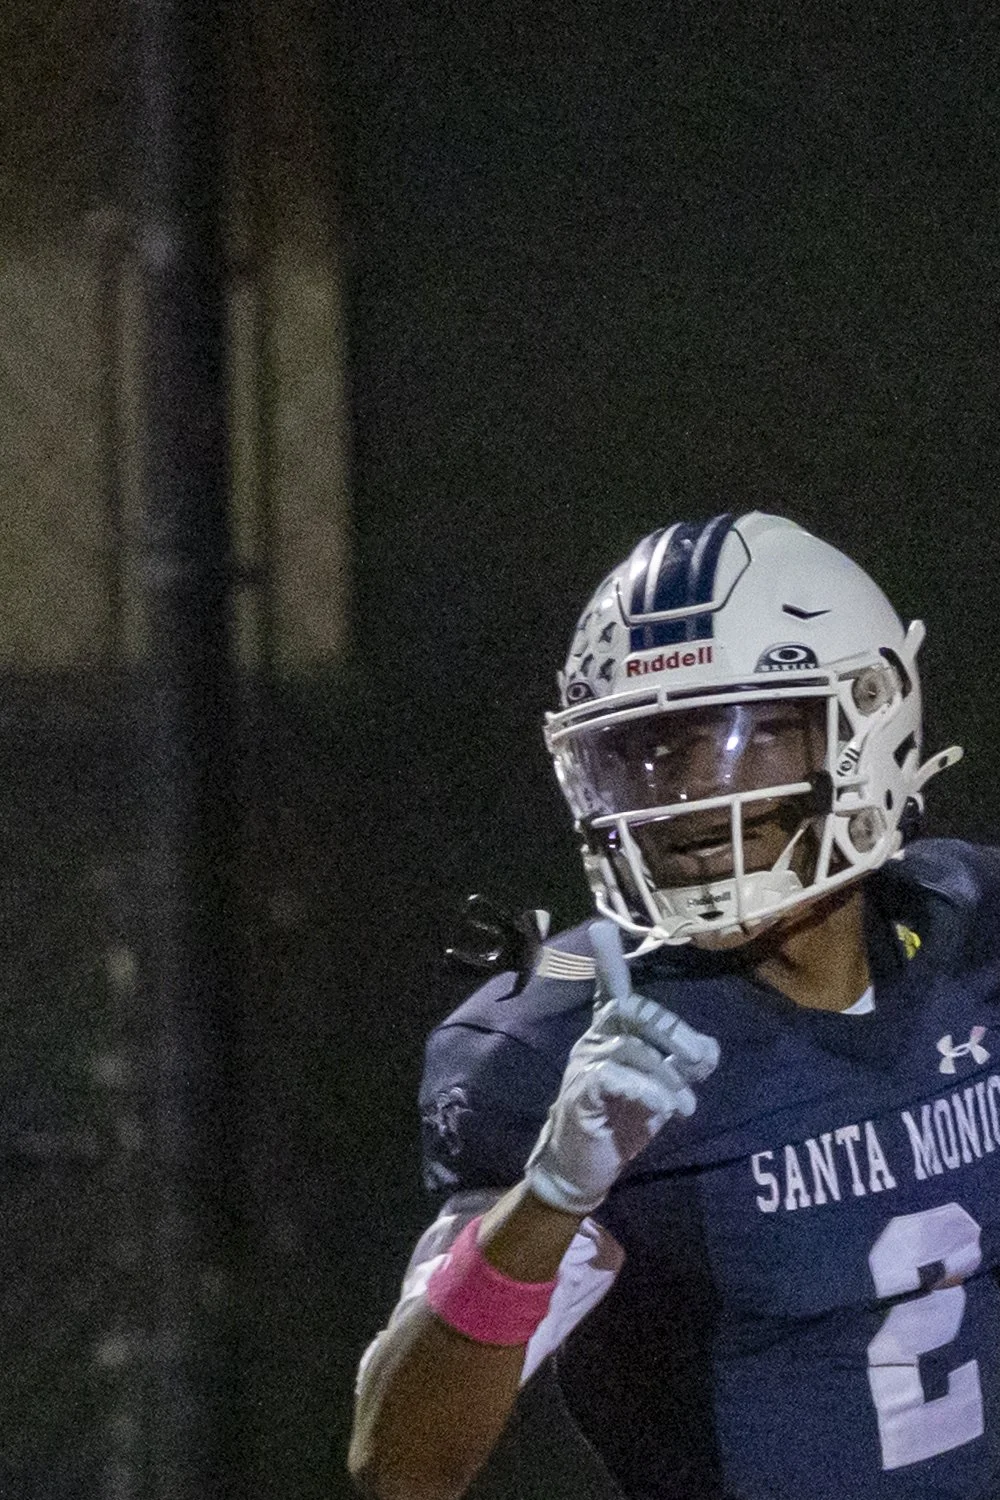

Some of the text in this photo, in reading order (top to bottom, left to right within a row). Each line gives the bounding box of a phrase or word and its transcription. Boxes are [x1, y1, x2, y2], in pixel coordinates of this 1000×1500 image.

[626, 646, 713, 678] Riddell
[751, 1121, 897, 1213] SANTA
[867, 1202, 984, 1470] 2
